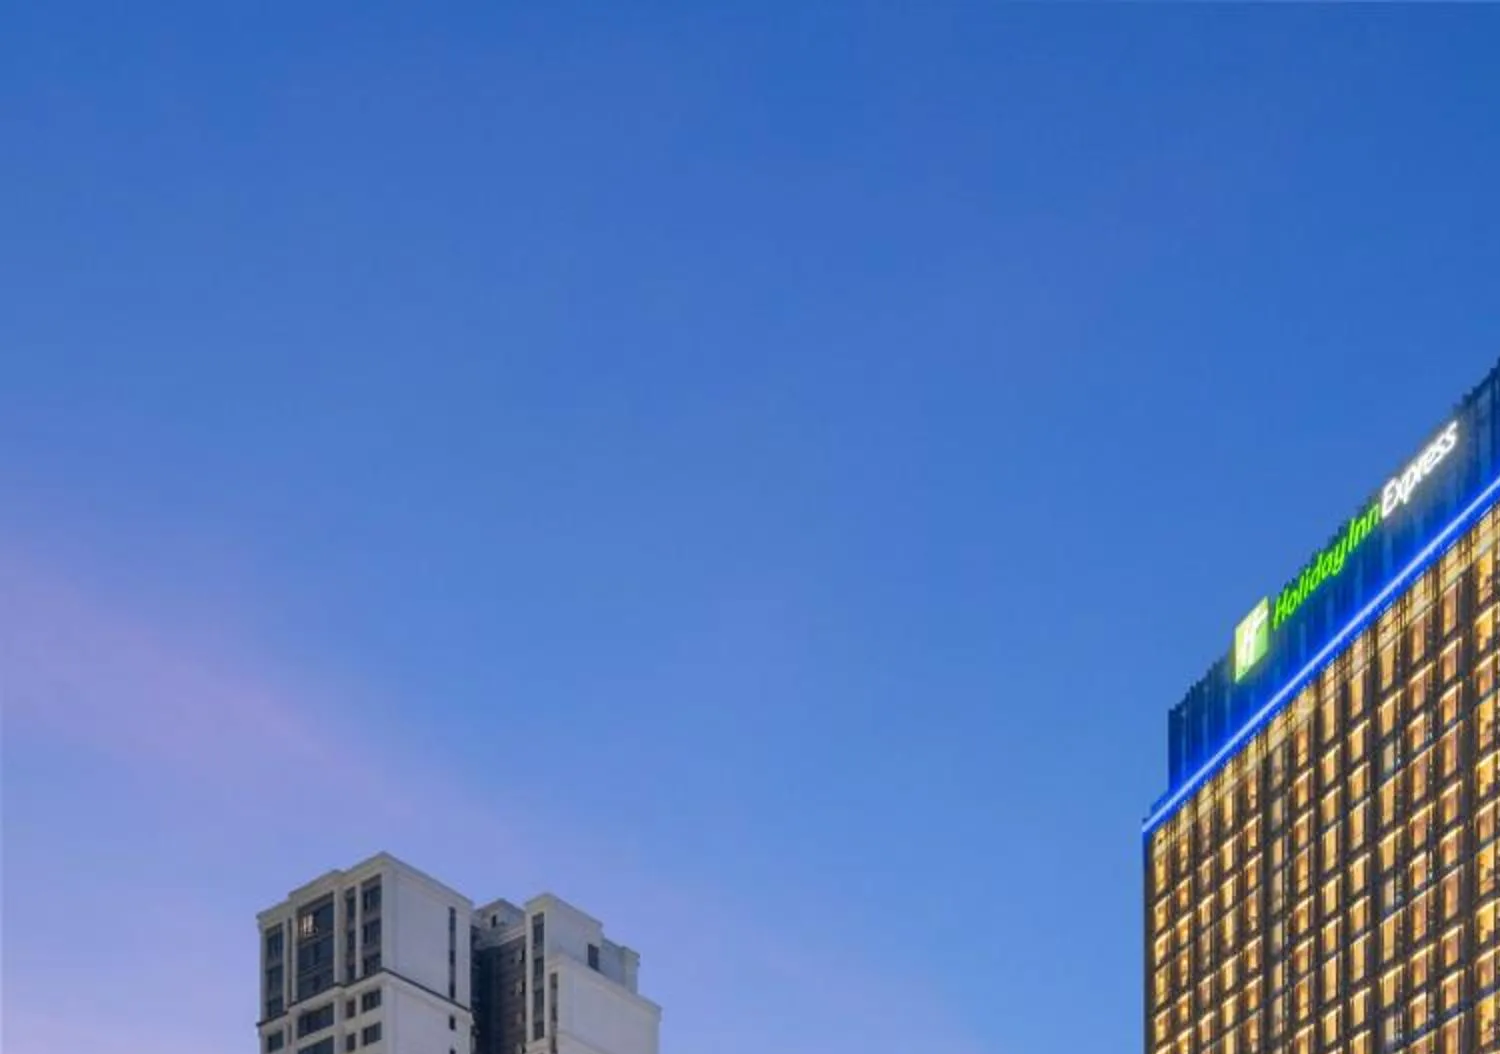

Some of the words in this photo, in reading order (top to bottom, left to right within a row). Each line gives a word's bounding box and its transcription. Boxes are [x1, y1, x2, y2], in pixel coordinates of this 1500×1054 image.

[1273, 536, 1346, 629] Holiday
[1347, 501, 1381, 553] Inn
[1381, 420, 1459, 519] Express
